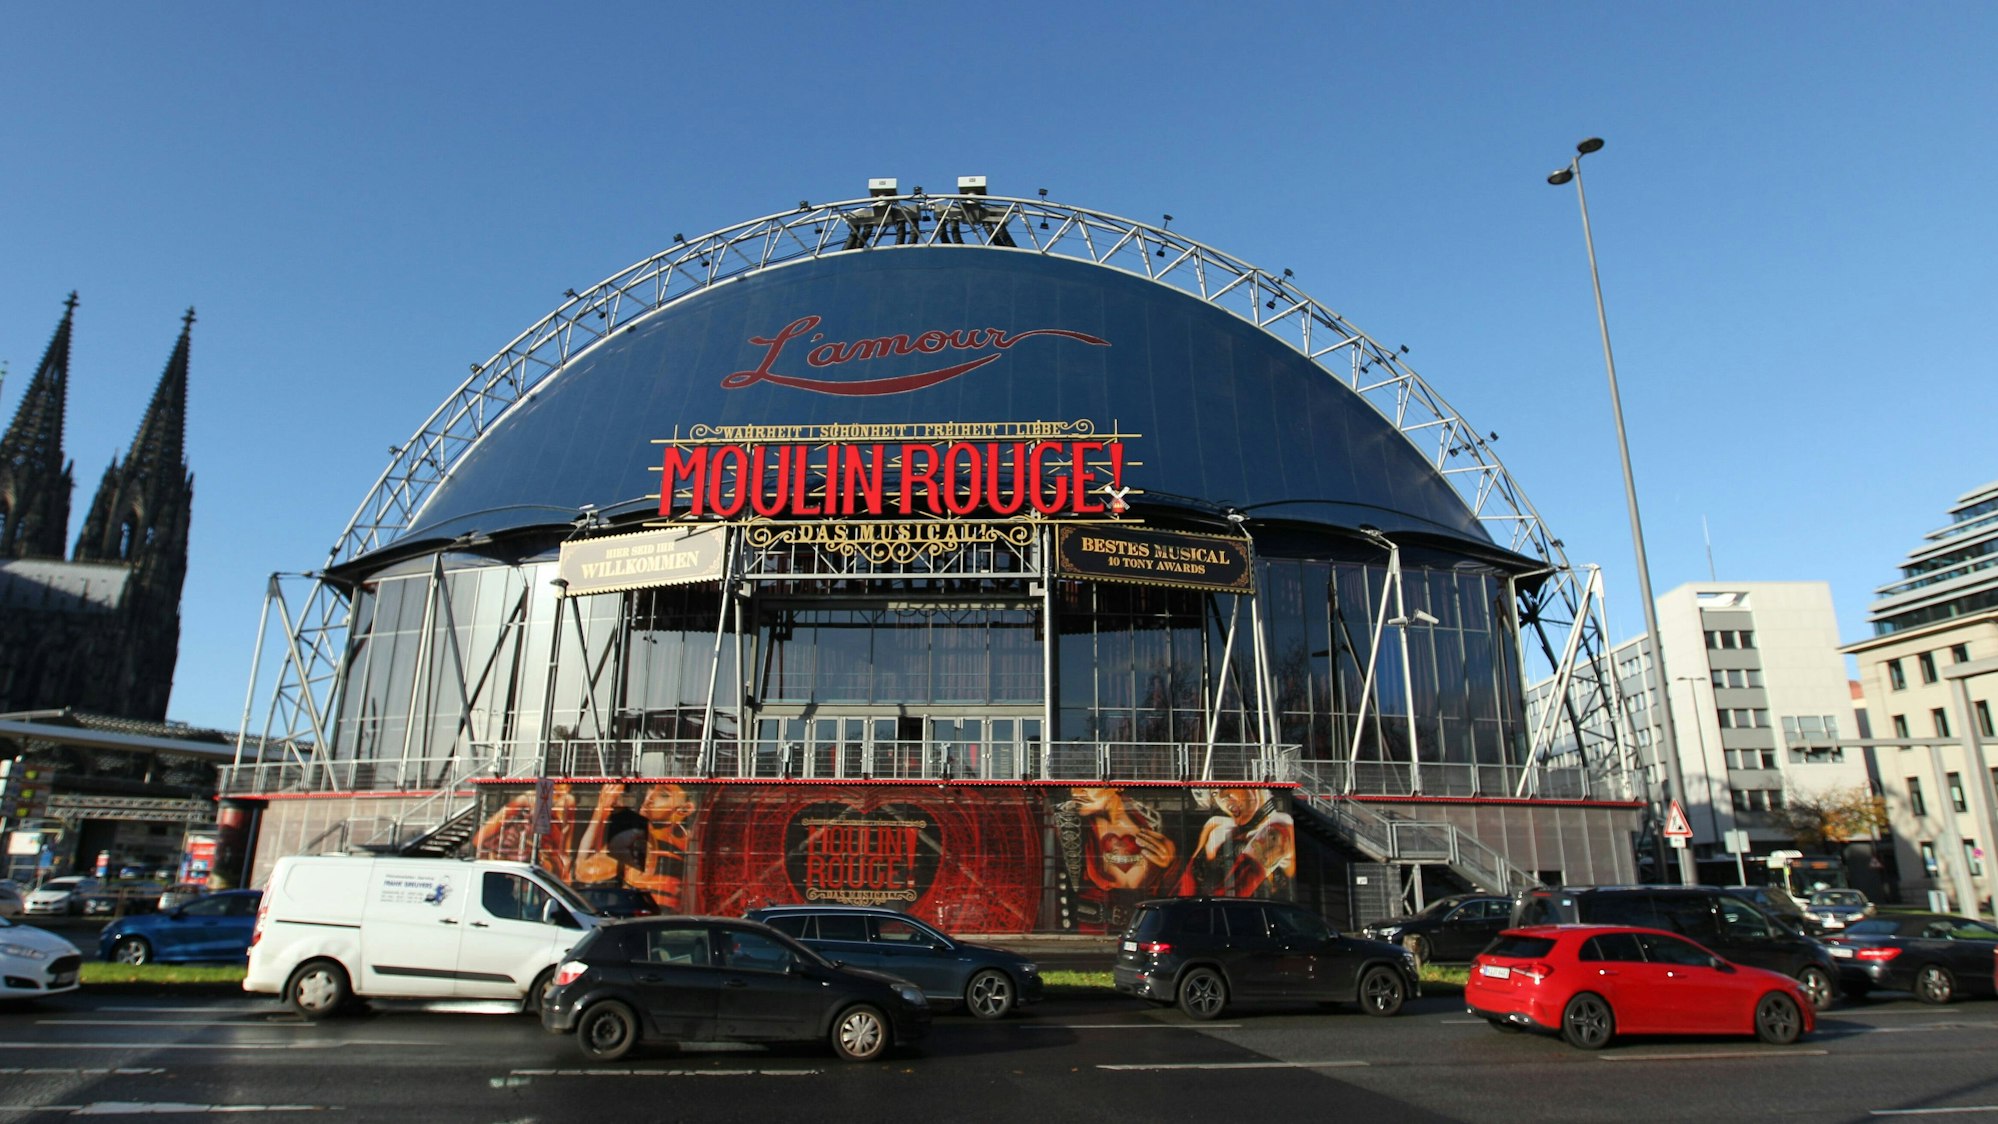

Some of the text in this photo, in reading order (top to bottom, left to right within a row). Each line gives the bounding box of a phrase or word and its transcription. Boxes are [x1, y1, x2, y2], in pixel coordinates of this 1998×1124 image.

[720, 315, 1112, 396] L'amour
[723, 423, 1061, 439] WAHRHEIT SCHÖNHEIT FREIHEIT LIEBE
[658, 441, 1130, 517] MOULIN ROUGE!
[801, 524, 987, 541] DAS MUSICAL!
[606, 541, 675, 558] HIER SEID IHR
[1081, 536, 1230, 564] BESTES MUSICAL
[581, 551, 700, 580] WILLKOMMEN
[1108, 556, 1206, 575] 10 TONY AWARDS
[806, 825, 902, 855] MOULIN
[826, 890, 845, 900] DAS
